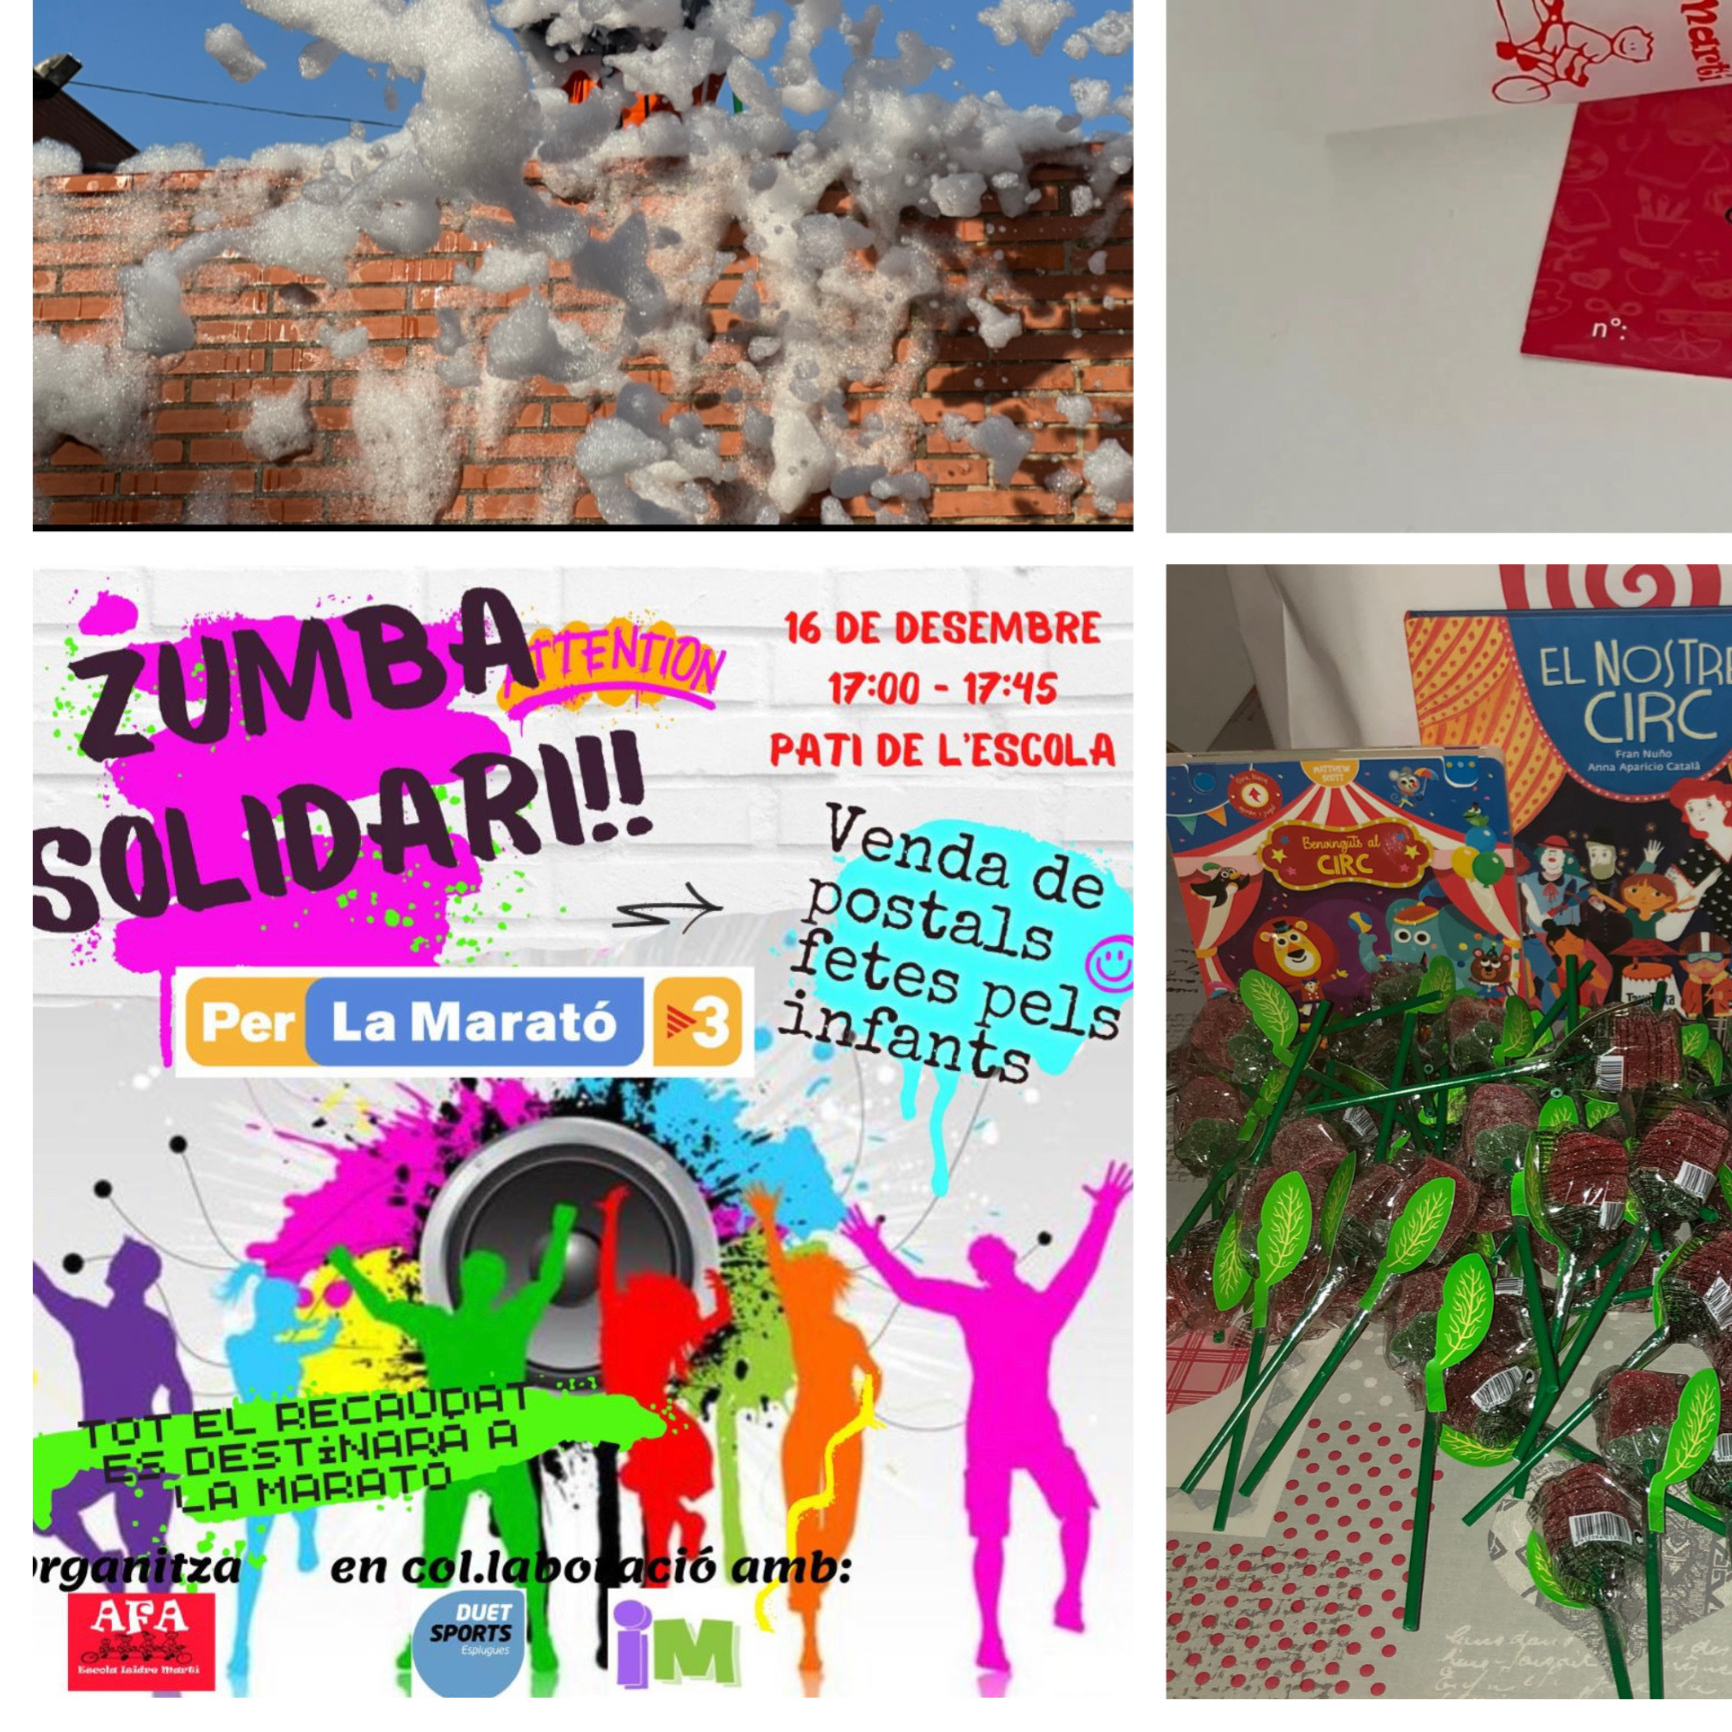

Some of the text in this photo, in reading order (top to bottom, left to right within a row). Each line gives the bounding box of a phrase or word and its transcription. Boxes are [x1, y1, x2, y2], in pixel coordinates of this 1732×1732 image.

[784, 610, 1102, 645] 16 DE DESEMBRE
[68, 587, 539, 762] ZUMBA
[504, 624, 727, 698] TTENTION
[1540, 646, 1586, 686] EL
[828, 671, 920, 706] 17:00
[963, 671, 1058, 706] 17:45
[1584, 689, 1718, 743] CIRC
[769, 731, 1116, 767] PATI DE L'ESCOLA
[1615, 749, 1672, 759] Fran Nuño
[1588, 762, 1616, 773] Anna
[1620, 762, 1664, 774] Aparicio
[32, 729, 653, 934] SOLIDARI!!
[1302, 834, 1381, 854] Benvinguts al
[826, 801, 1104, 910] Venda de
[1317, 853, 1374, 875] CIRC
[800, 877, 1054, 962] postals
[790, 927, 1121, 1041] fetes pels
[203, 1000, 617, 1042] Per La Marató
[778, 989, 1031, 1085] infants
[78, 1382, 531, 1449] TOT EL RECAUDAT
[103, 1451, 165, 1484] ES
[488, 1419, 518, 1449] A
[175, 1480, 239, 1514] LA
[331, 1554, 387, 1584] en
[731, 1550, 852, 1584] amb:
[90, 1599, 190, 1635] AFA
[456, 1603, 513, 1621] DUET
[429, 1624, 513, 1642] SPORTS
[461, 1644, 510, 1656] Esplugues
[78, 1665, 117, 1674] Escola
[121, 1665, 158, 1674] Isidre
